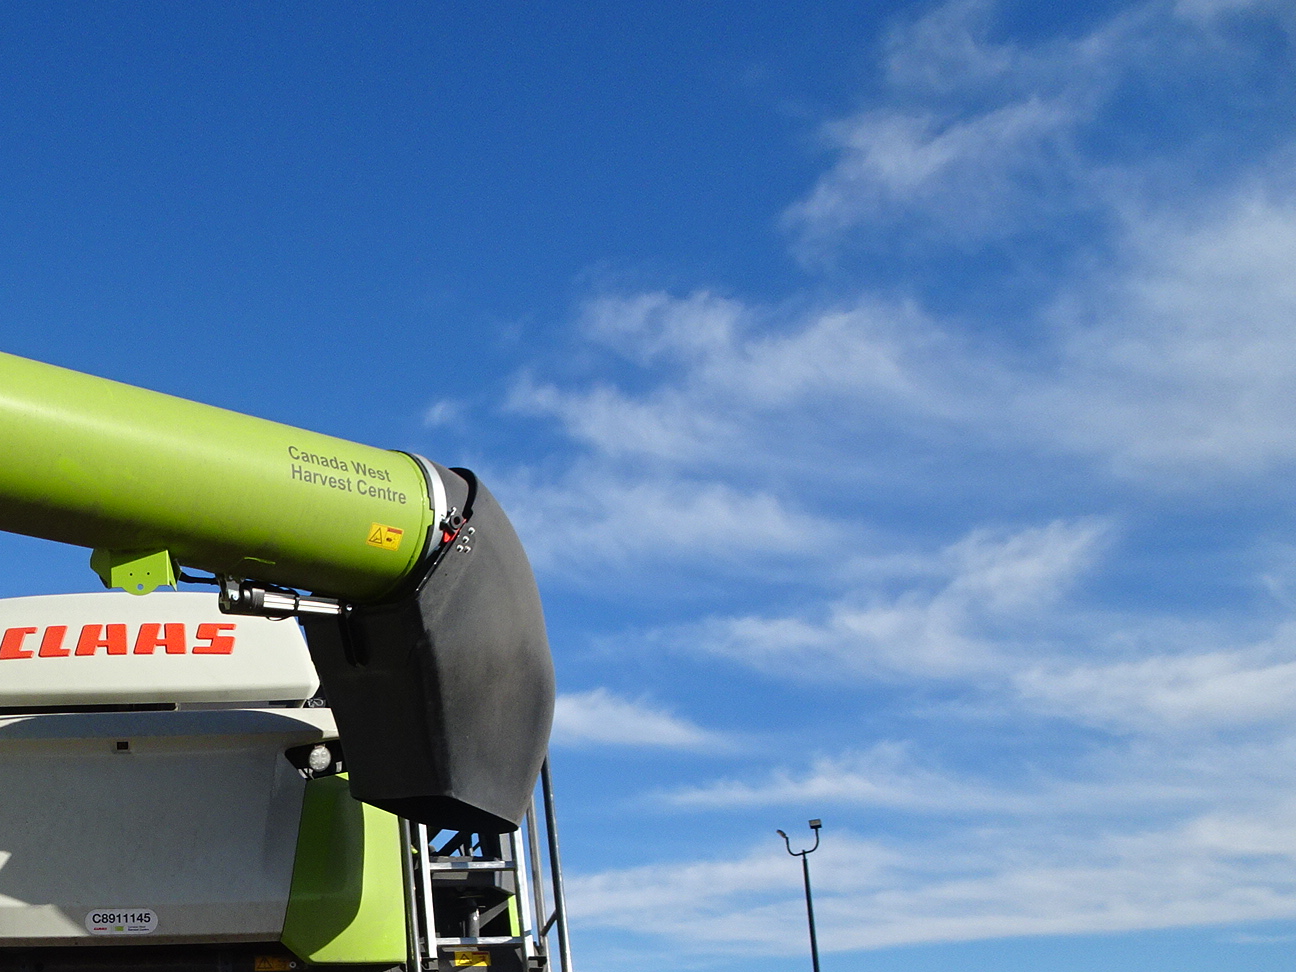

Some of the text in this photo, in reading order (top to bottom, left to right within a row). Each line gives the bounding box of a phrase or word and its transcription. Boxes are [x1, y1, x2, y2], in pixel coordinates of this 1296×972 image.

[288, 446, 392, 482] Canada West
[291, 463, 407, 504] Harvest Centre
[92, 912, 151, 924] C8911145
